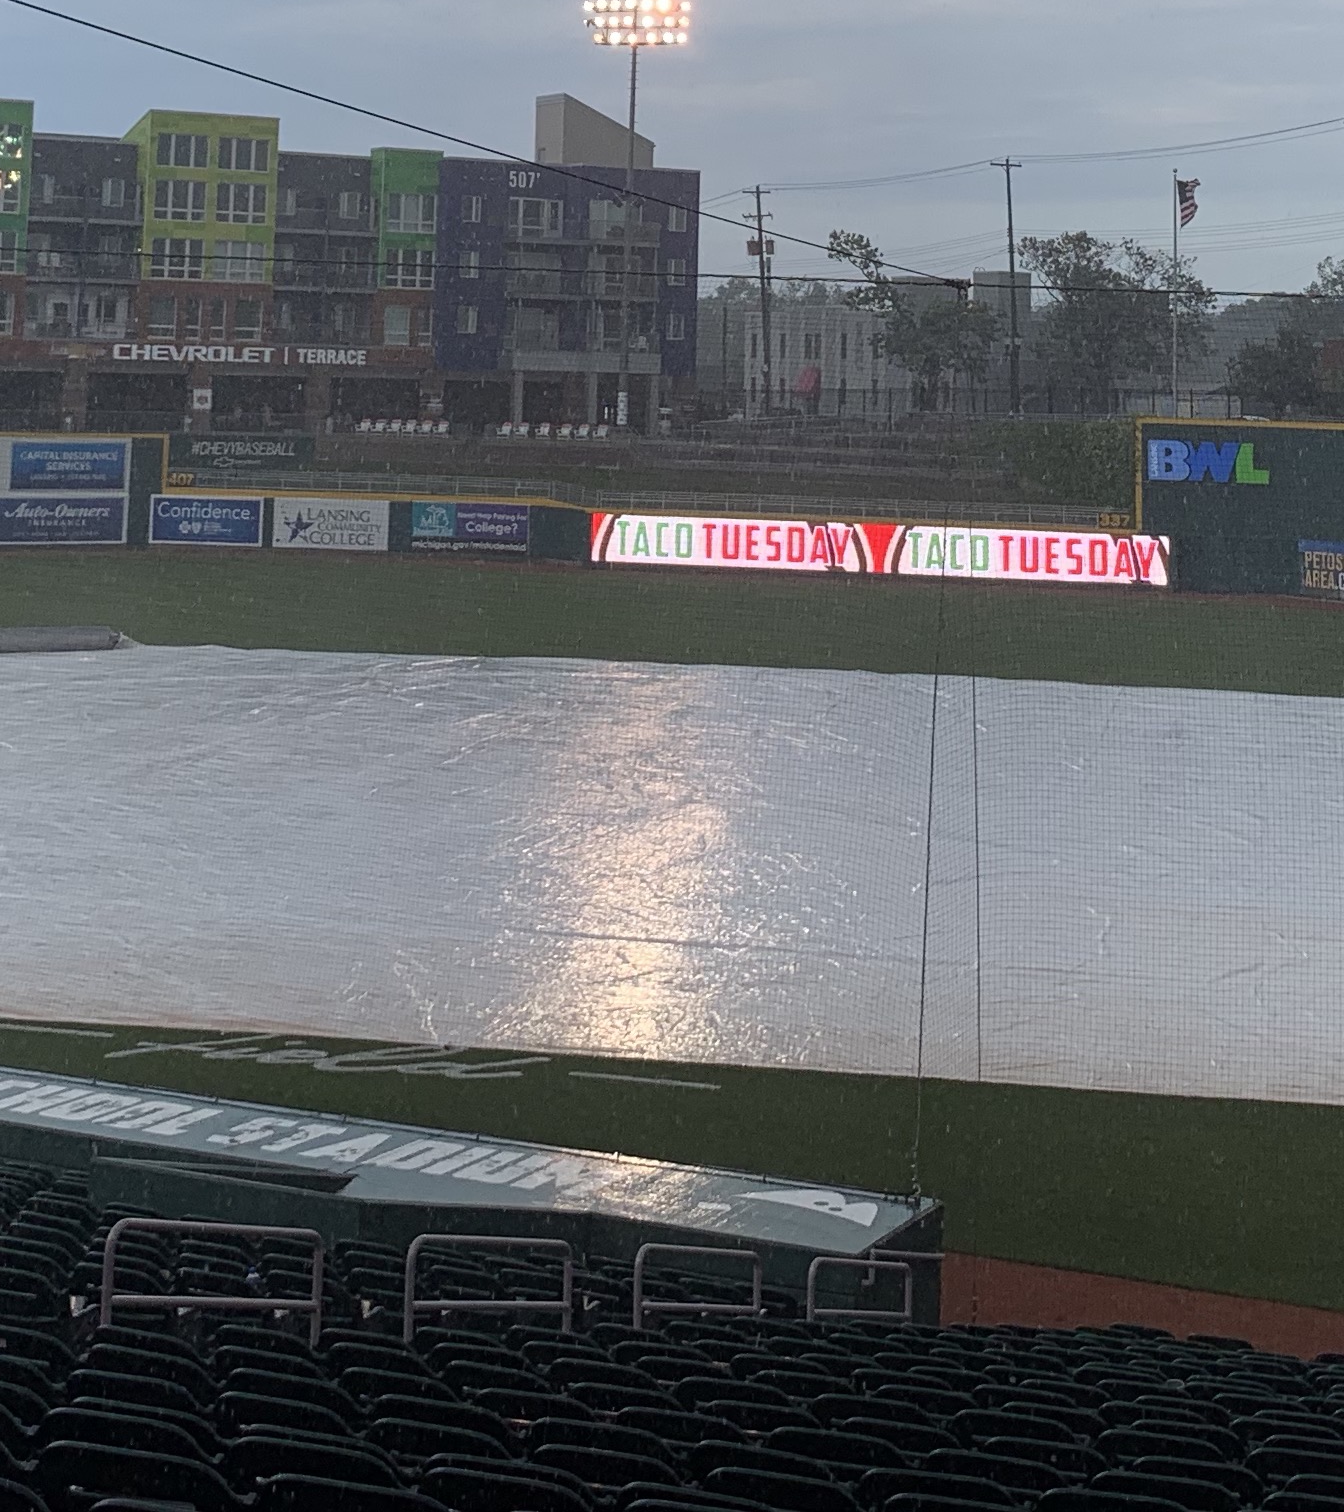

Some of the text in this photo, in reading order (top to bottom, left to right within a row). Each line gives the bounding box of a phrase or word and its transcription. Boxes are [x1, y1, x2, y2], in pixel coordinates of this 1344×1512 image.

[509, 170, 541, 188] 507'
[113, 344, 367, 365] CHEVROLET TERRACE
[20, 451, 118, 461] CAPITAL INSURANCE
[192, 441, 295, 456] #CHEVYBASEBALL
[46, 461, 93, 471] SERVICES
[1148, 439, 1270, 485] BWL
[4, 502, 111, 518] Auto-Owners
[307, 508, 371, 523] LANSING
[317, 522, 382, 533] COMMUNITY
[466, 521, 518, 535] College?
[309, 531, 375, 546] COLLEGE
[616, 520, 853, 565] TACO TUESDAY
[907, 531, 1159, 579] TACO TUESDAY
